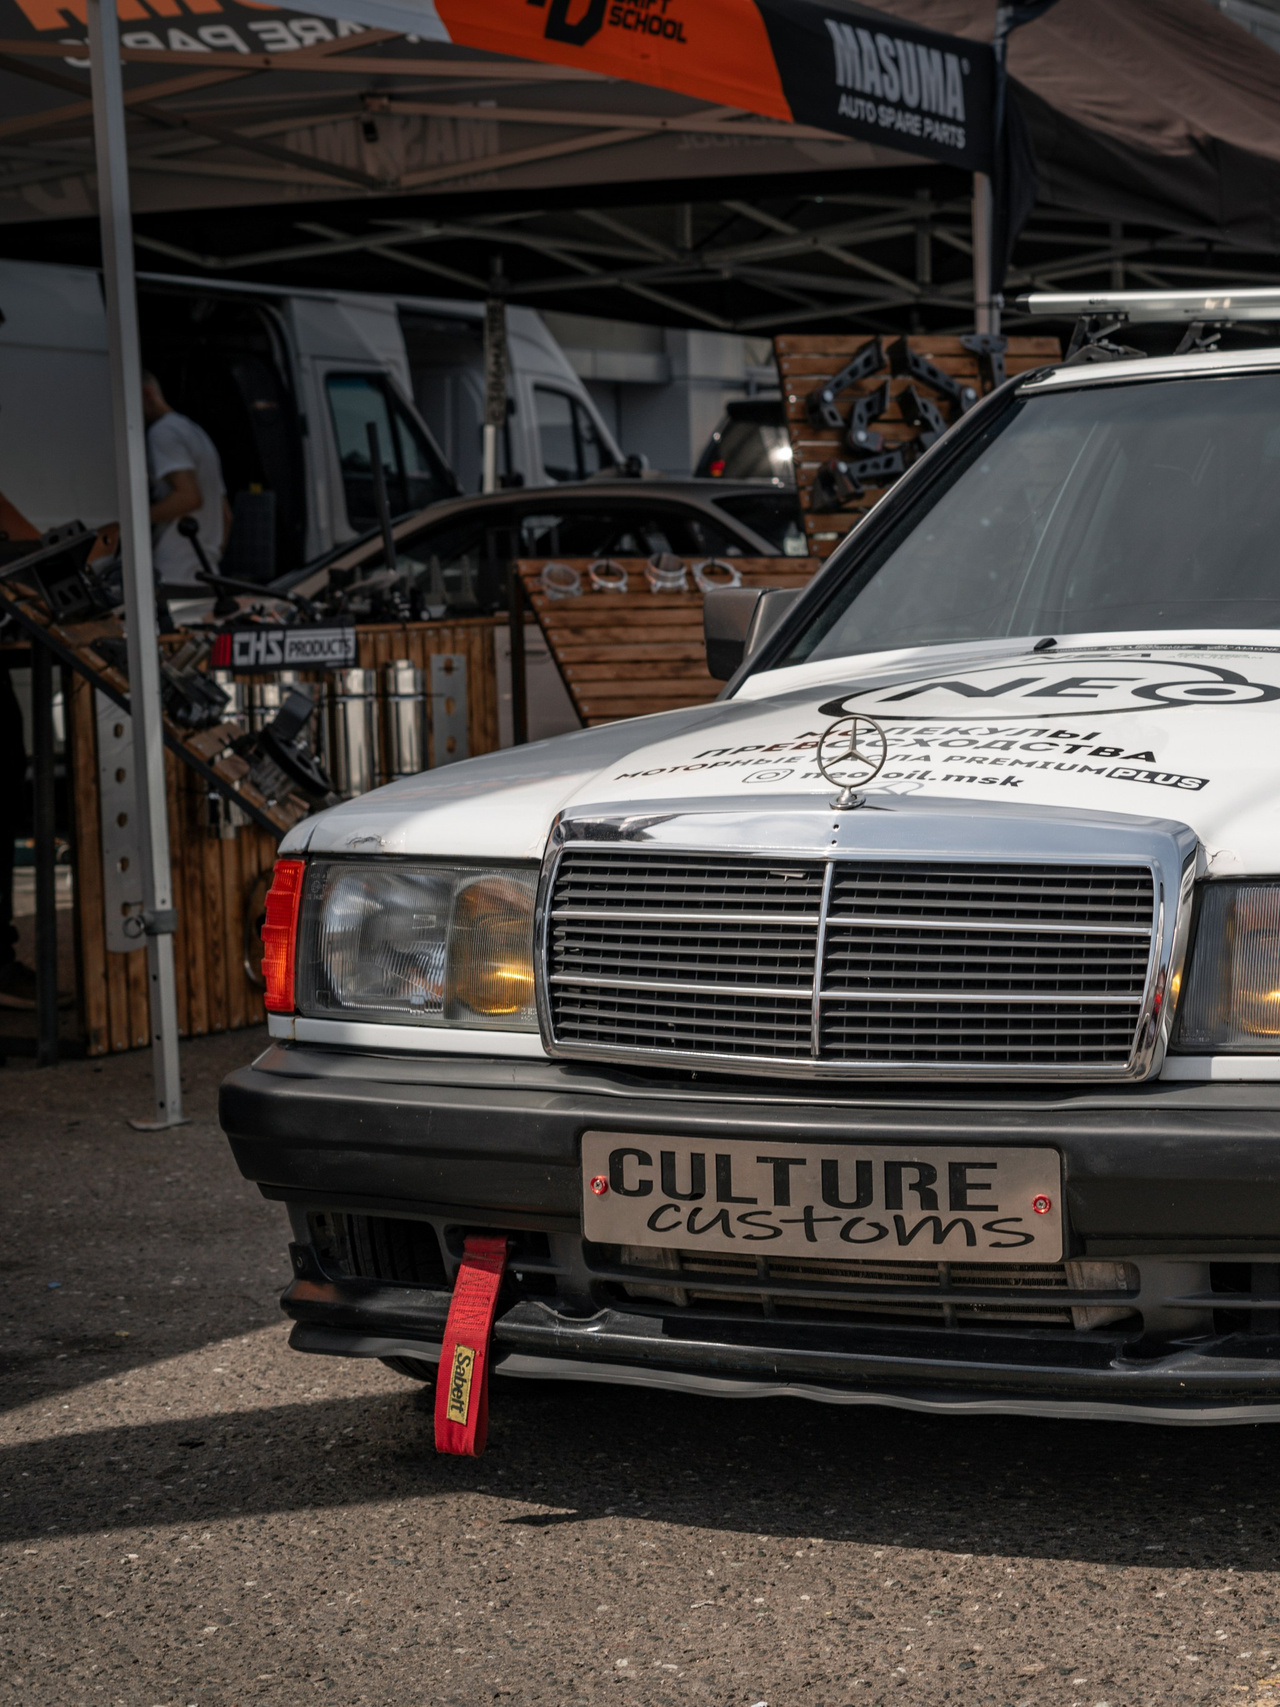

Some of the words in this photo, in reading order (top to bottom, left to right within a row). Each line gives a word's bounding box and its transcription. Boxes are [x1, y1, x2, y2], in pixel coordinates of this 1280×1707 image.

[608, 5, 687, 45] SCHOOL
[825, 18, 967, 121] MASUMA
[838, 94, 878, 123] AUTO
[878, 104, 924, 137] SPARE
[922, 115, 967, 150] PARTS
[233, 630, 285, 666] CHS
[289, 636, 352, 659] PRODUCTS
[692, 738, 1157, 763] ПРЕВОСХОДСТВА
[793, 727, 1101, 741] МОЛЕКУЛЫ
[614, 756, 806, 781] МОТОРНЫЕ
[942, 755, 1108, 775] PREMIUM
[1111, 767, 1203, 790] PLUS
[800, 769, 1024, 788] neooil.msk
[608, 1147, 999, 1213] CULTURE
[646, 1202, 1035, 1248] customs
[450, 1352, 471, 1415] Sabelt
